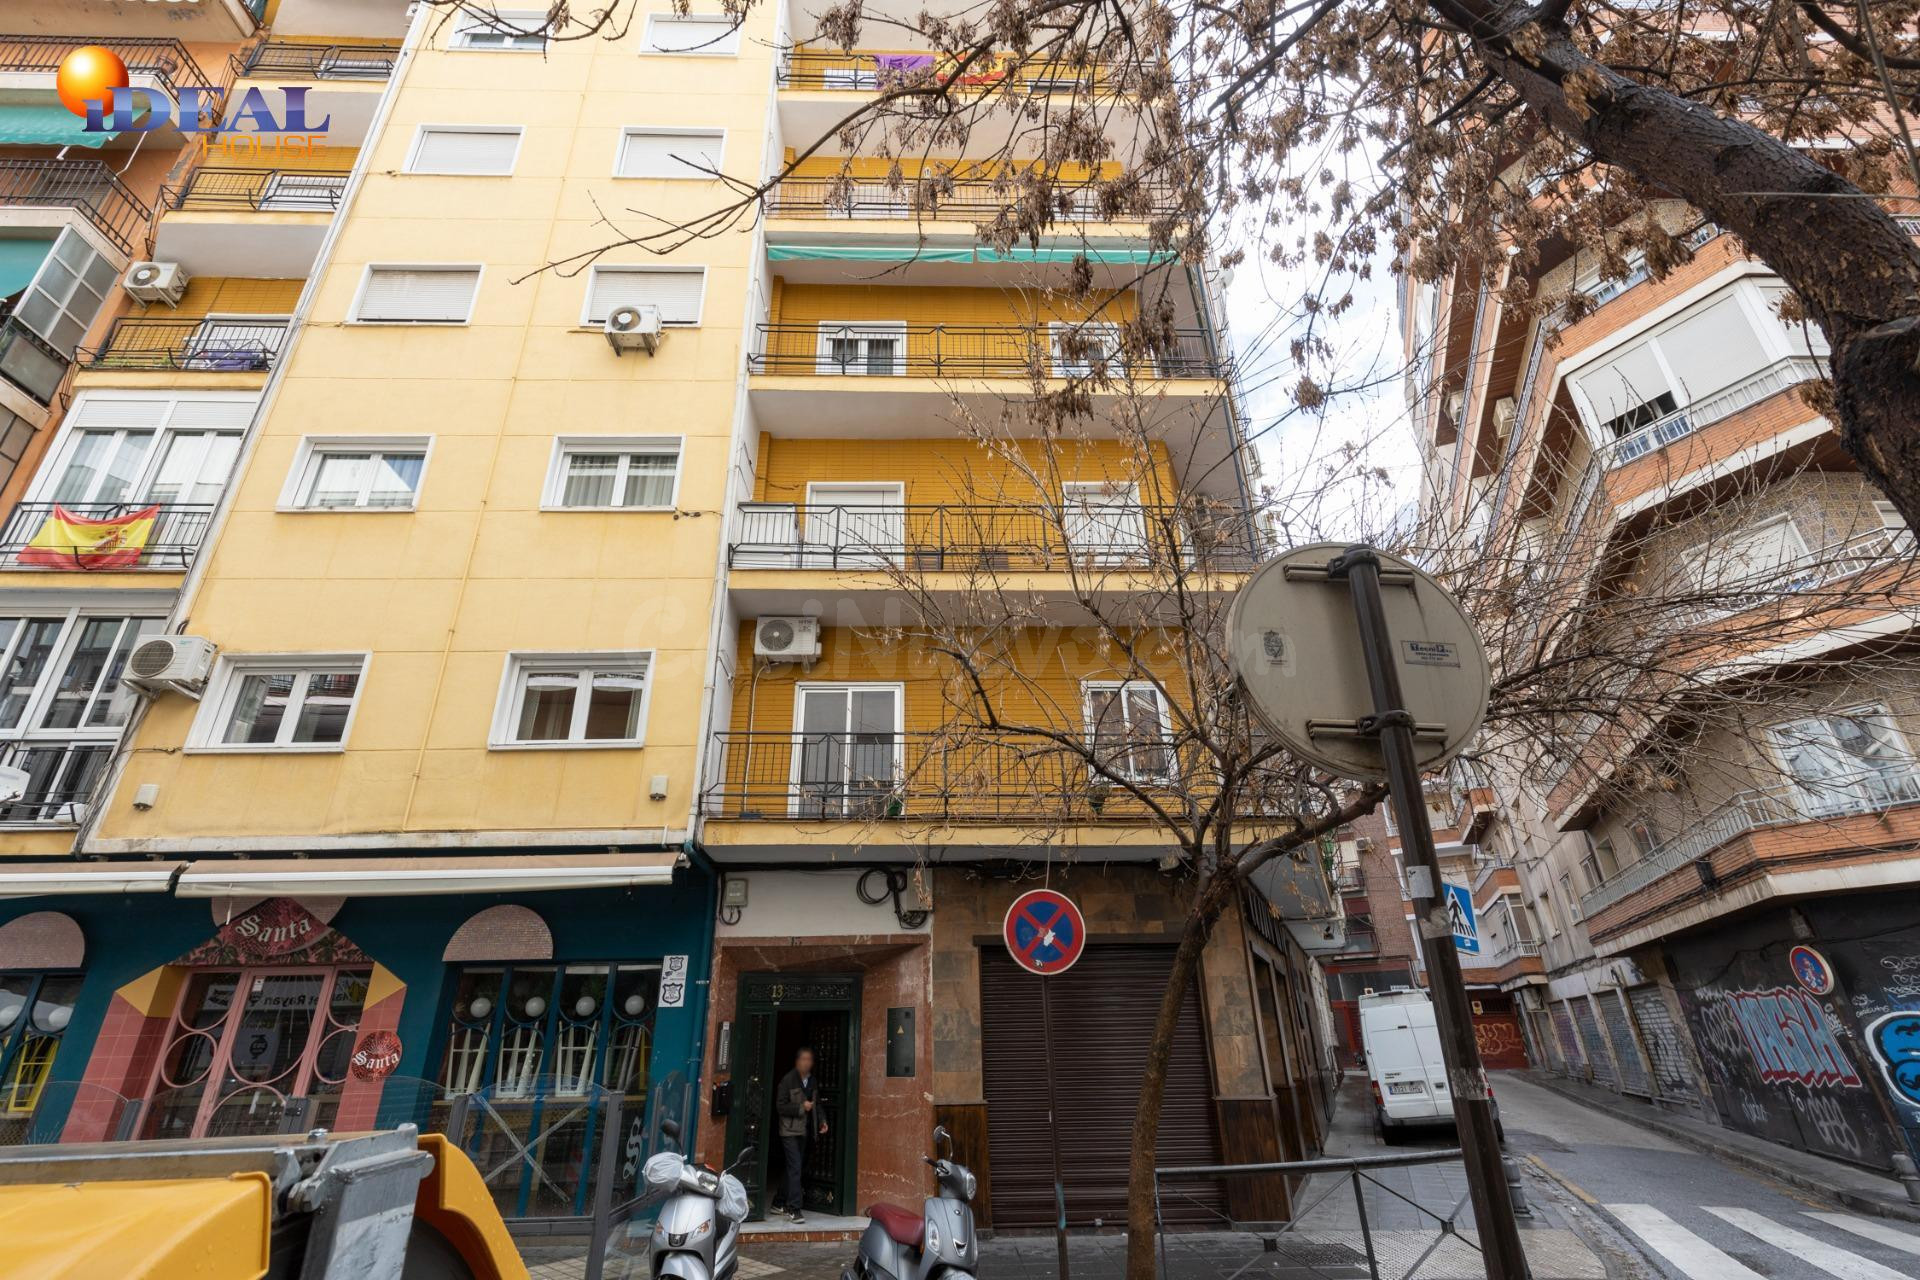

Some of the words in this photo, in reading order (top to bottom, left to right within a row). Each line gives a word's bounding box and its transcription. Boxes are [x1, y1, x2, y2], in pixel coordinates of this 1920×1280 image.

[235, 914, 312, 943] Santa
[772, 984, 784, 998] 13
[352, 1050, 400, 1070] Santa
